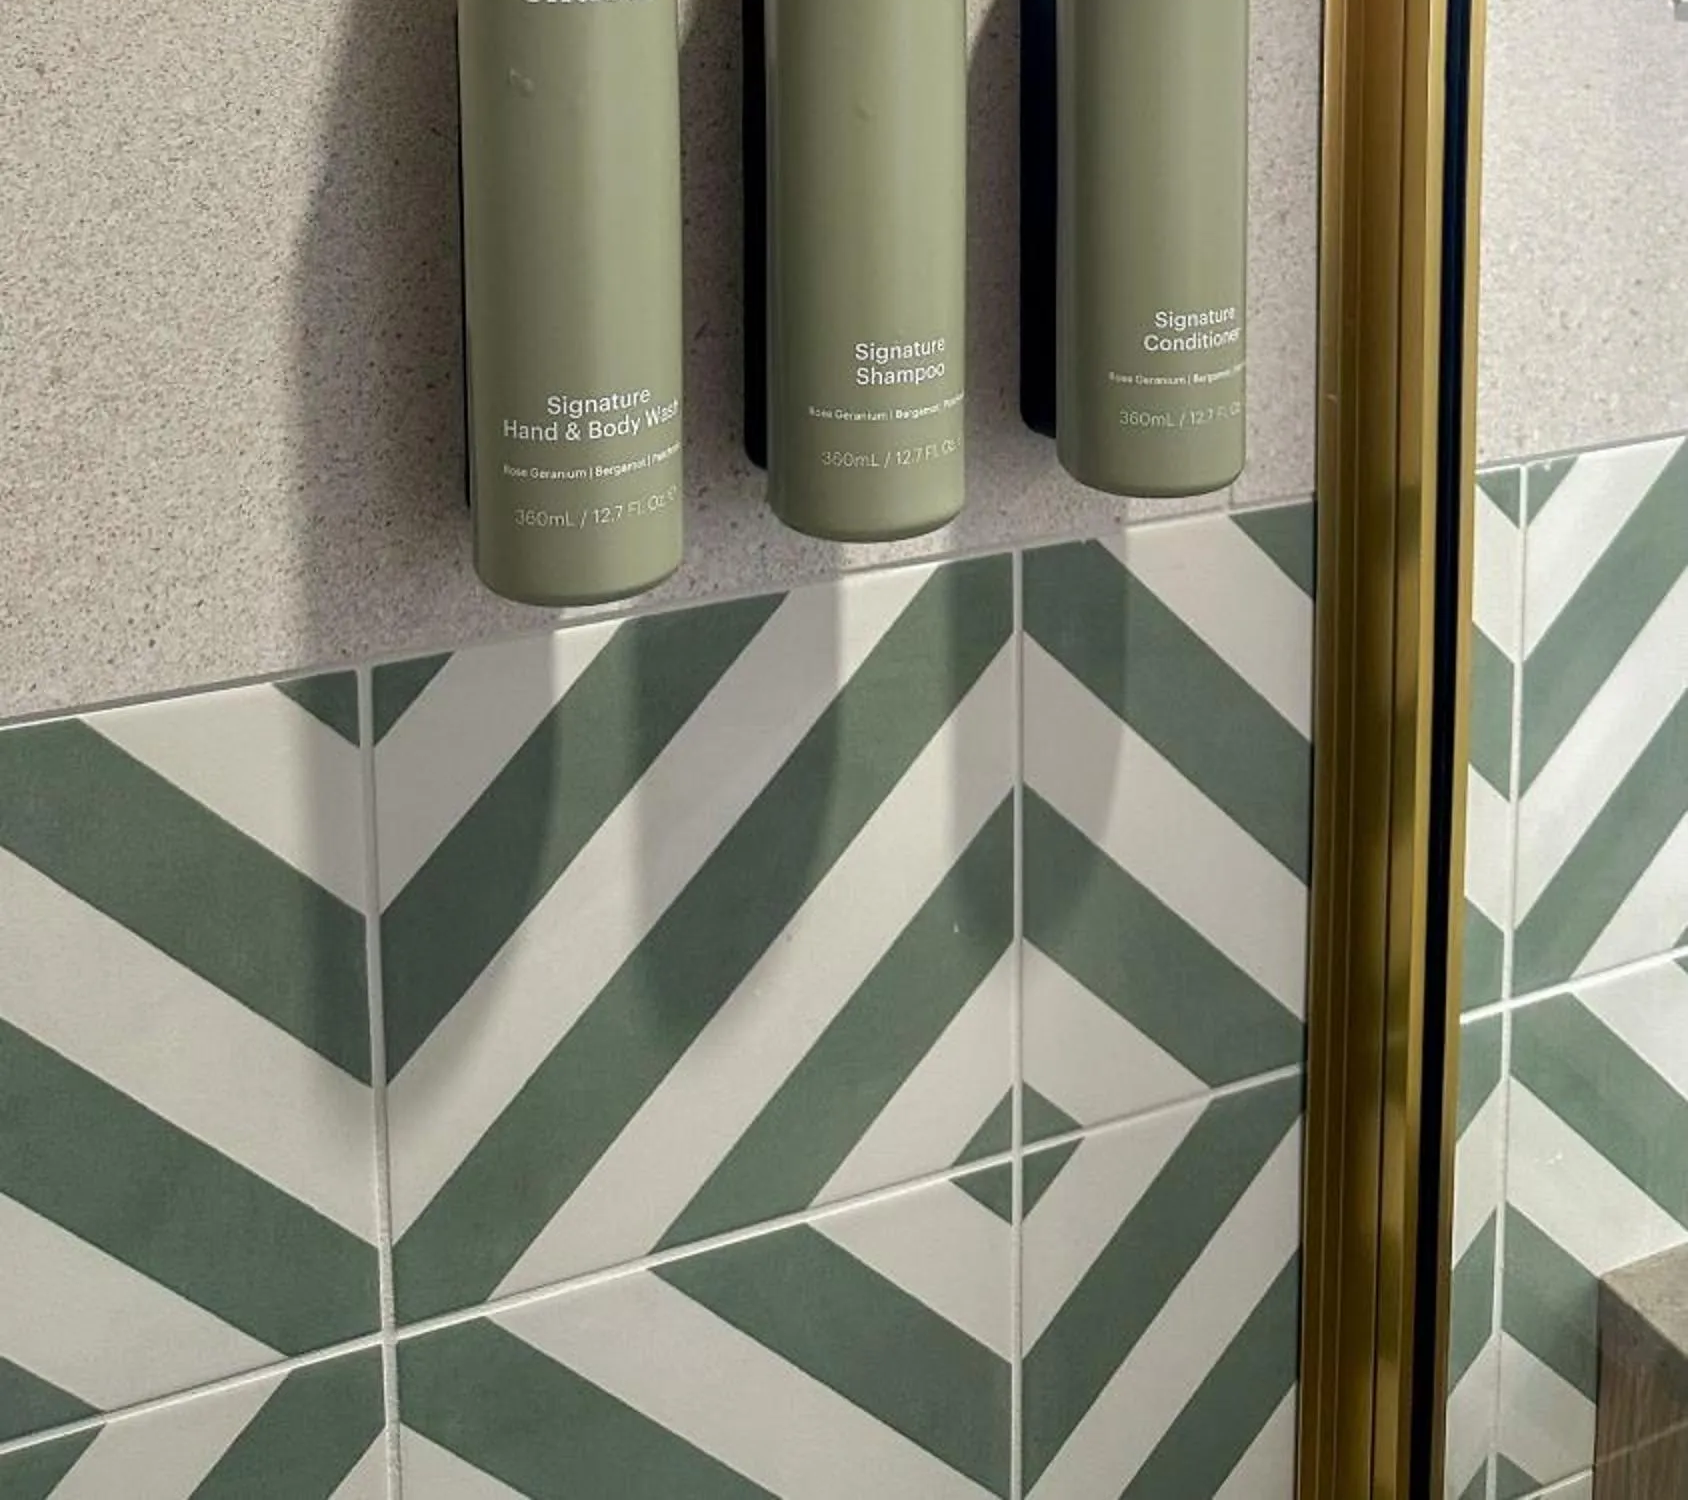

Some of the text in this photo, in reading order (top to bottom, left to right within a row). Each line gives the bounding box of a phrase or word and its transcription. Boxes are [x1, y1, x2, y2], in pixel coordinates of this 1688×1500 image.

[1154, 307, 1236, 332] Signature
[855, 337, 945, 364] Signature
[855, 362, 945, 386] Shampoo
[547, 388, 651, 418] Signature
[503, 419, 558, 441] Hand
[565, 420, 581, 441] &
[588, 414, 641, 440] Body
[1119, 411, 1177, 427] 360mL
[514, 509, 575, 528] 360mL
[592, 505, 623, 525] 12.7
